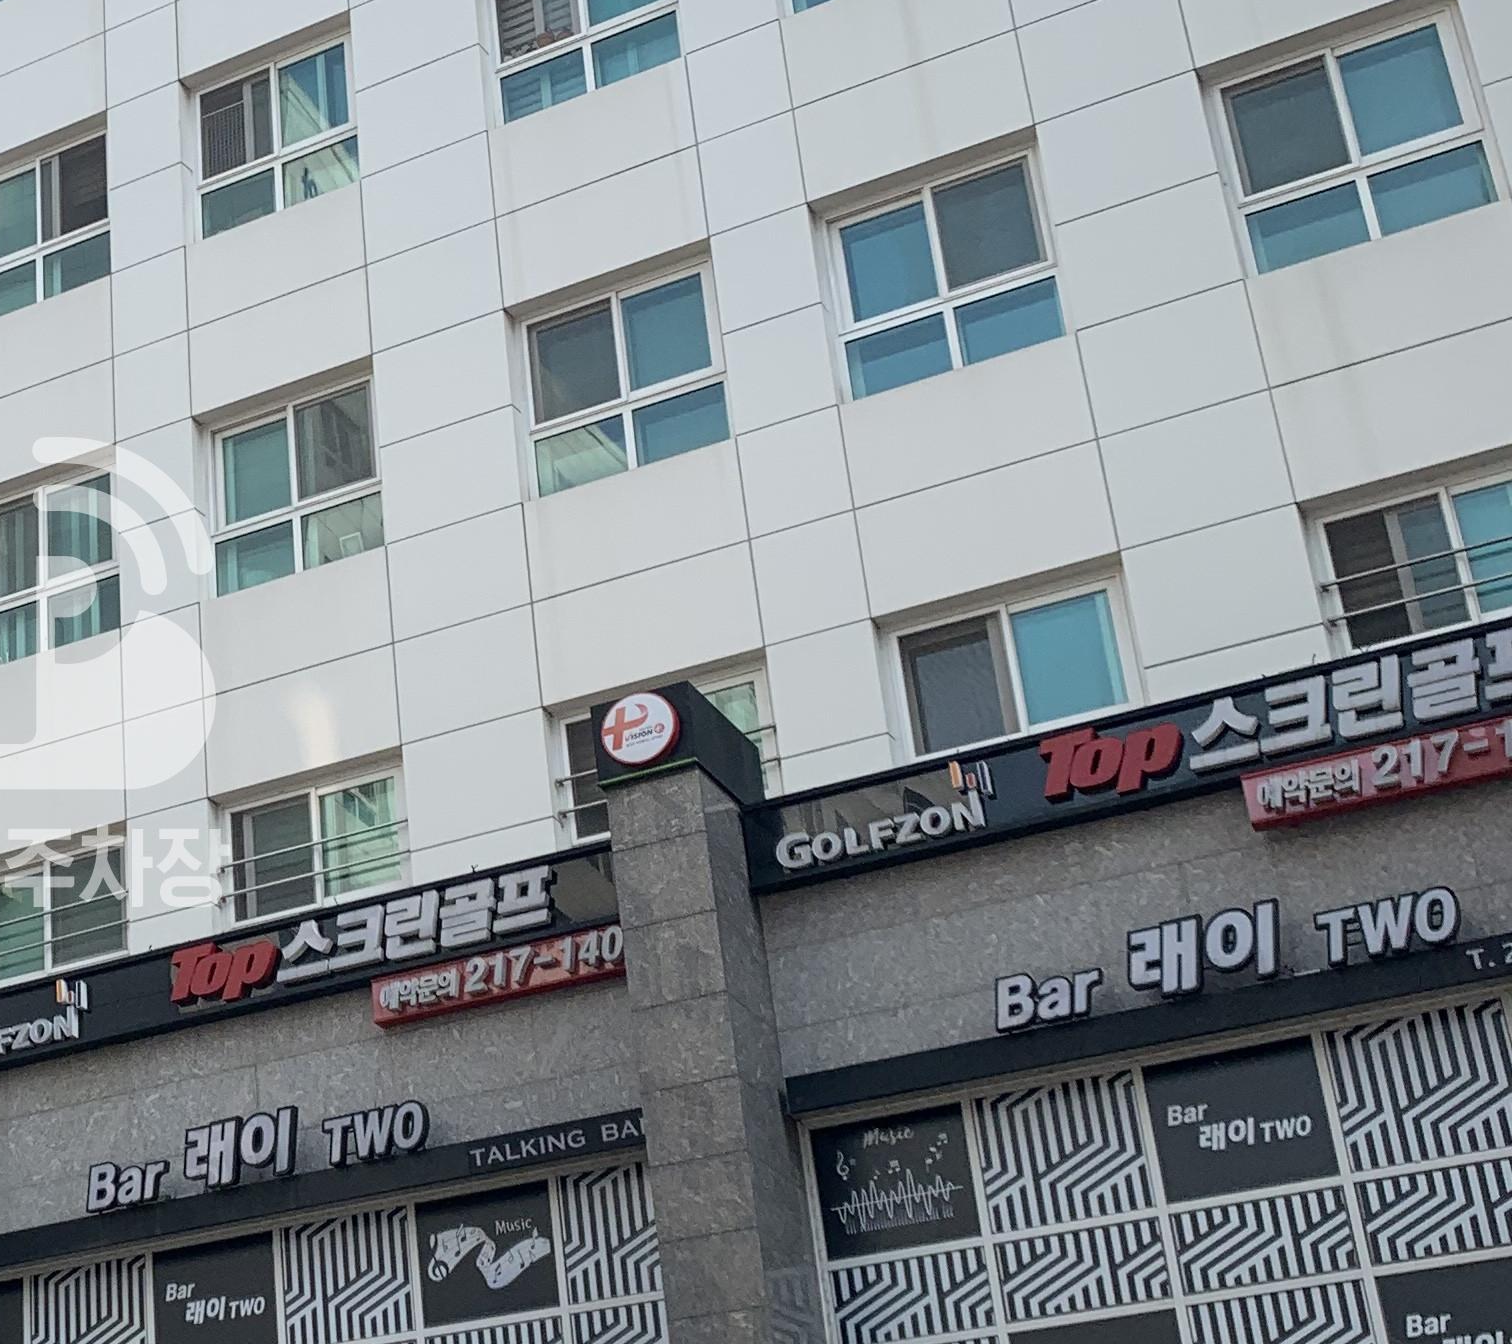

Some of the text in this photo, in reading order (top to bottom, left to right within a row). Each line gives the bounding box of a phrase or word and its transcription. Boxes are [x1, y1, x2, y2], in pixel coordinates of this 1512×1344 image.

[1039, 722, 1183, 803] Top
[776, 790, 986, 870] GOLFZON
[171, 864, 557, 1008] Top 스크린골프
[995, 886, 1461, 1032] Bar 래이 TWO
[379, 975, 459, 1012] 예약문의
[1167, 1101, 1208, 1127] Bar
[470, 1115, 644, 1168] TALKING BA
[1198, 1115, 1312, 1152] 래이 TWO
[87, 1099, 430, 1213] Bar 래이 TWO
[495, 1216, 532, 1234] Music
[165, 1281, 195, 1302] Bar
[185, 1295, 266, 1325] 래이 TWO
[1405, 1312, 1451, 1339] Bar
